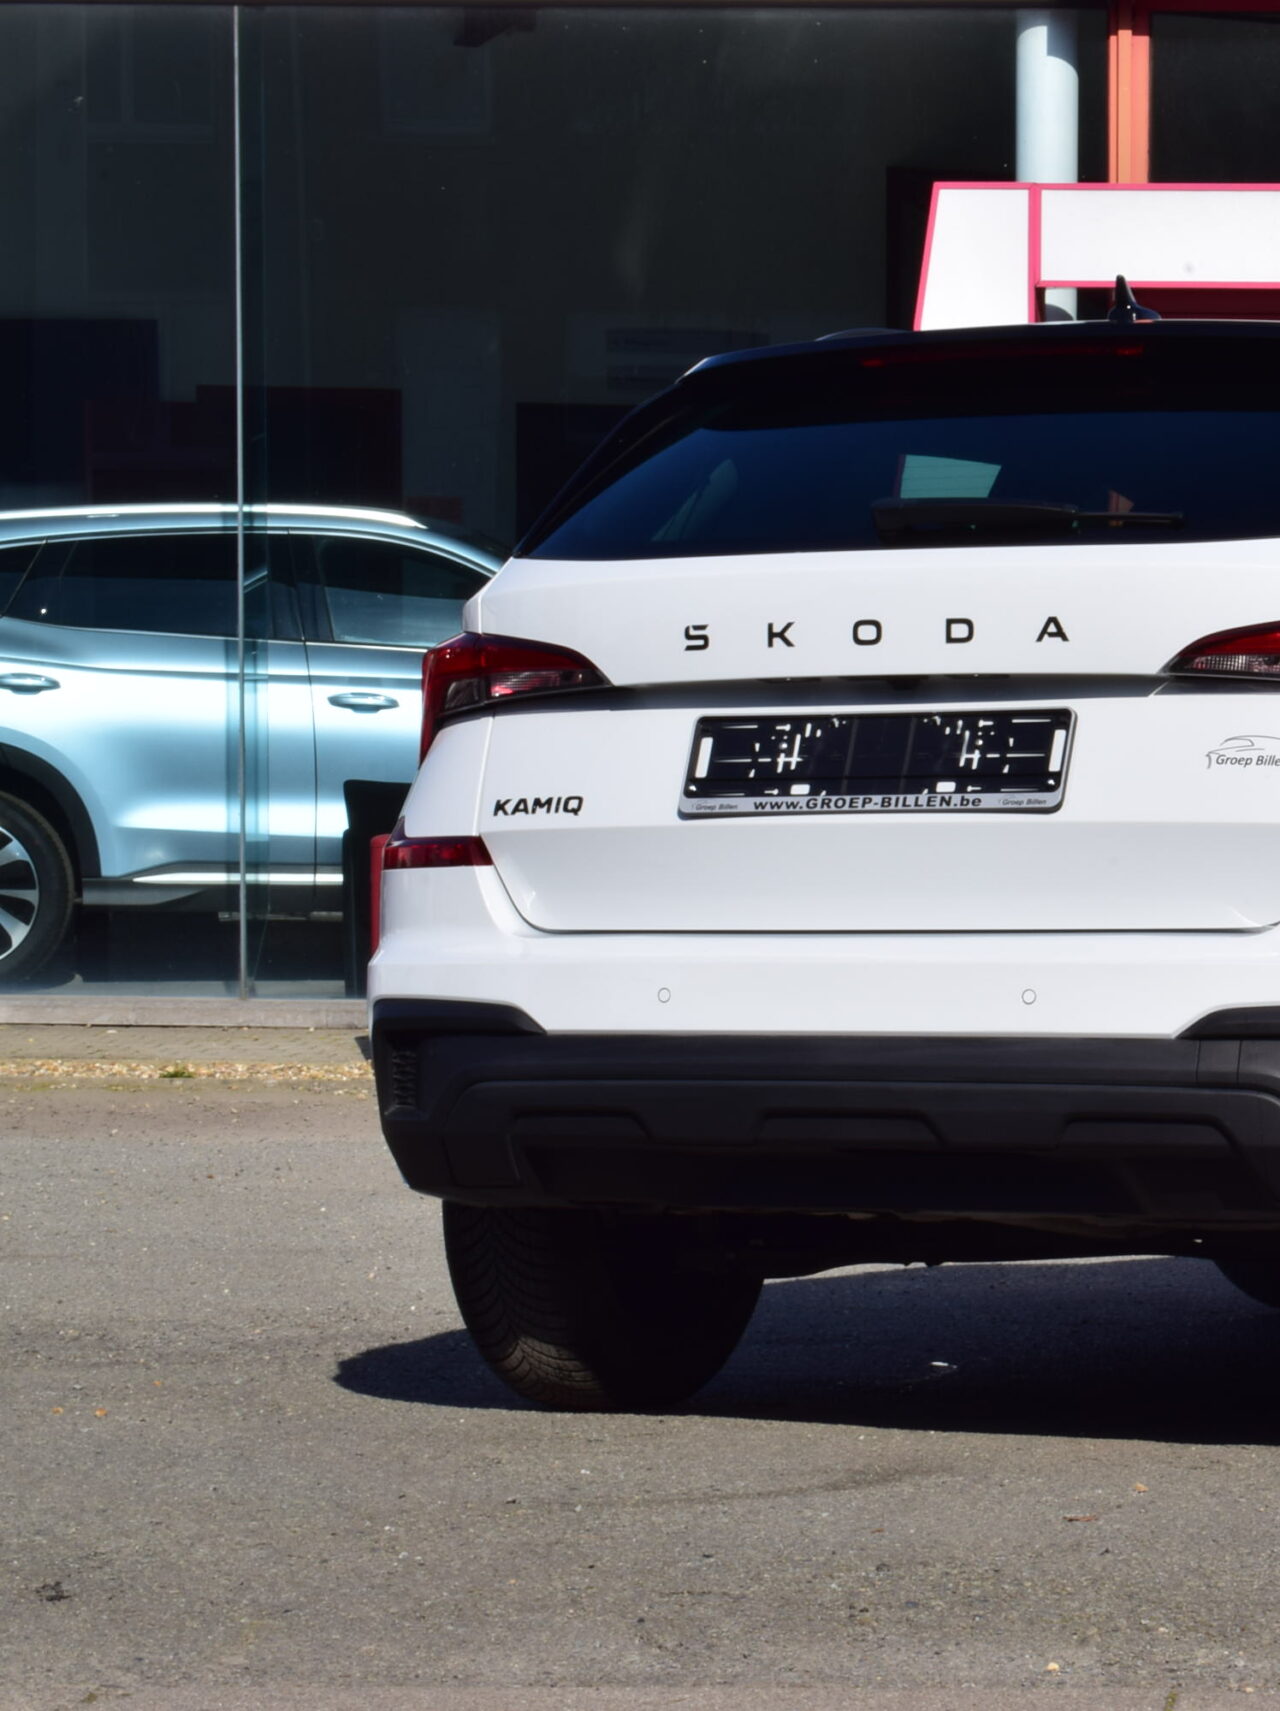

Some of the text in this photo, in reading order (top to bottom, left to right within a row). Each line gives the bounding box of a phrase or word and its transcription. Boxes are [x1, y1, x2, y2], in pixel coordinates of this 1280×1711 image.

[1215, 754, 1253, 768] Groep
[493, 795, 584, 817] KAMIQ
[754, 795, 983, 811] www.GROEP-BILLEN.be
